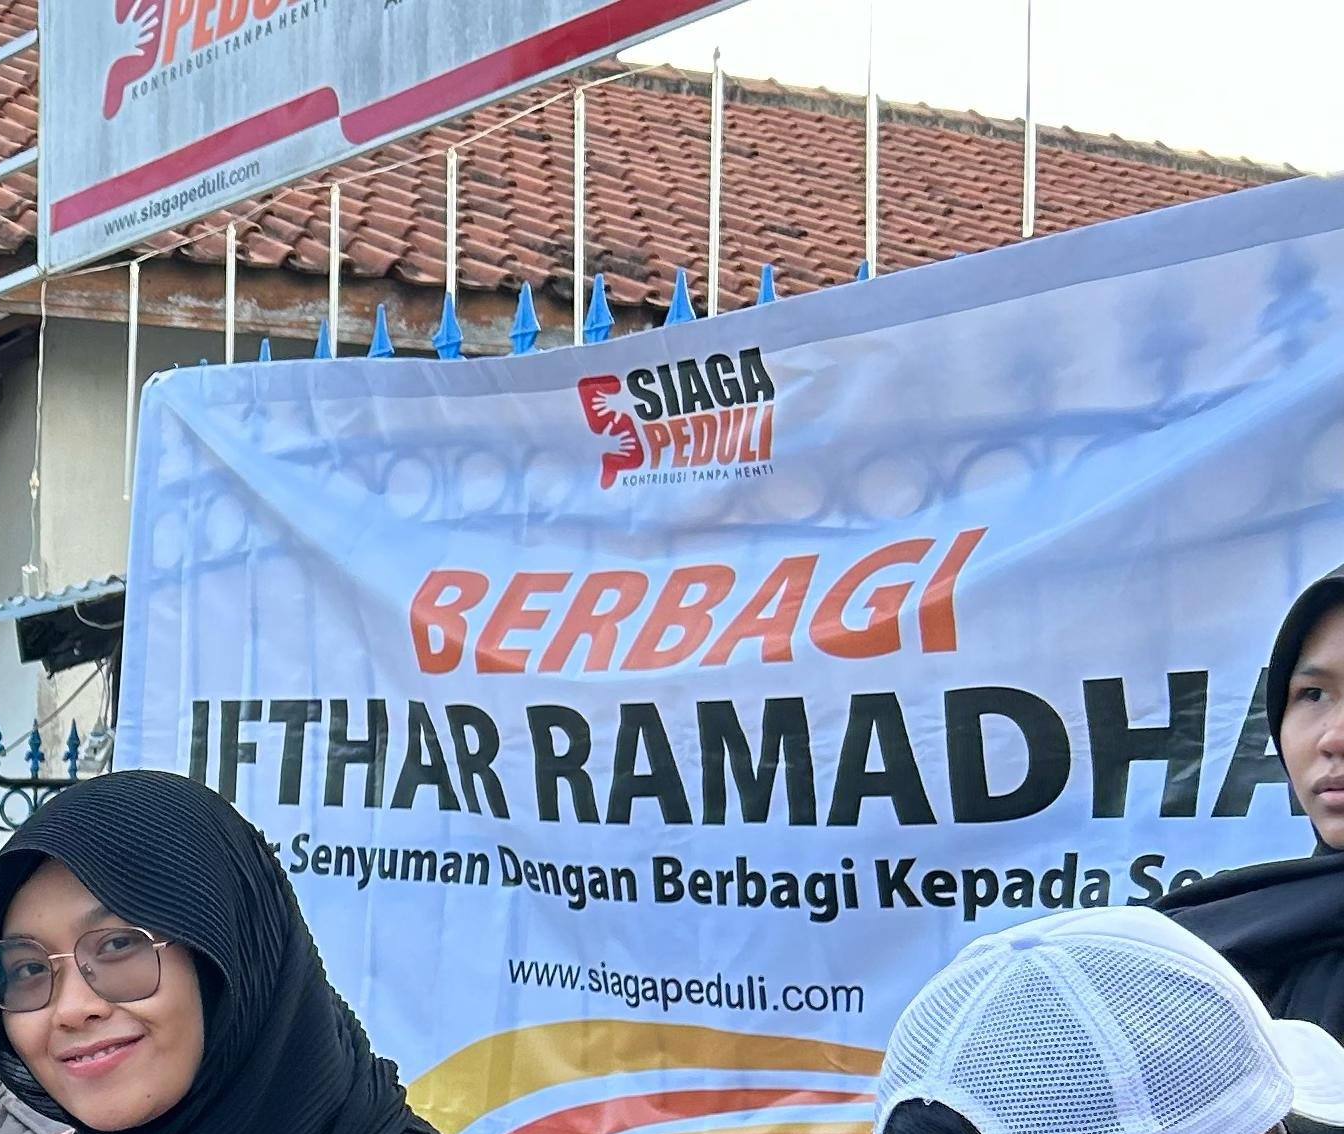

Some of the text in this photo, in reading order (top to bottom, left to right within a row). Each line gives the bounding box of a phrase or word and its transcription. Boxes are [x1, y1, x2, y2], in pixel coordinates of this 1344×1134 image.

[130, 45, 220, 100] KONTRIBUSI
[225, 24, 273, 54] TANPA
[104, 159, 261, 238] www.siagapeduli.com
[626, 347, 775, 421] SIAGA
[642, 404, 775, 470] PEDULI
[622, 465, 774, 487] KONTRIBUSI TANPA HENTI
[410, 527, 989, 675] BERBAGI
[189, 698, 511, 820] IFTHAR
[289, 833, 1233, 922] Senyuman Dengan Berbagi Kepada Se
[508, 959, 864, 1013] www.siagapeduli.com
